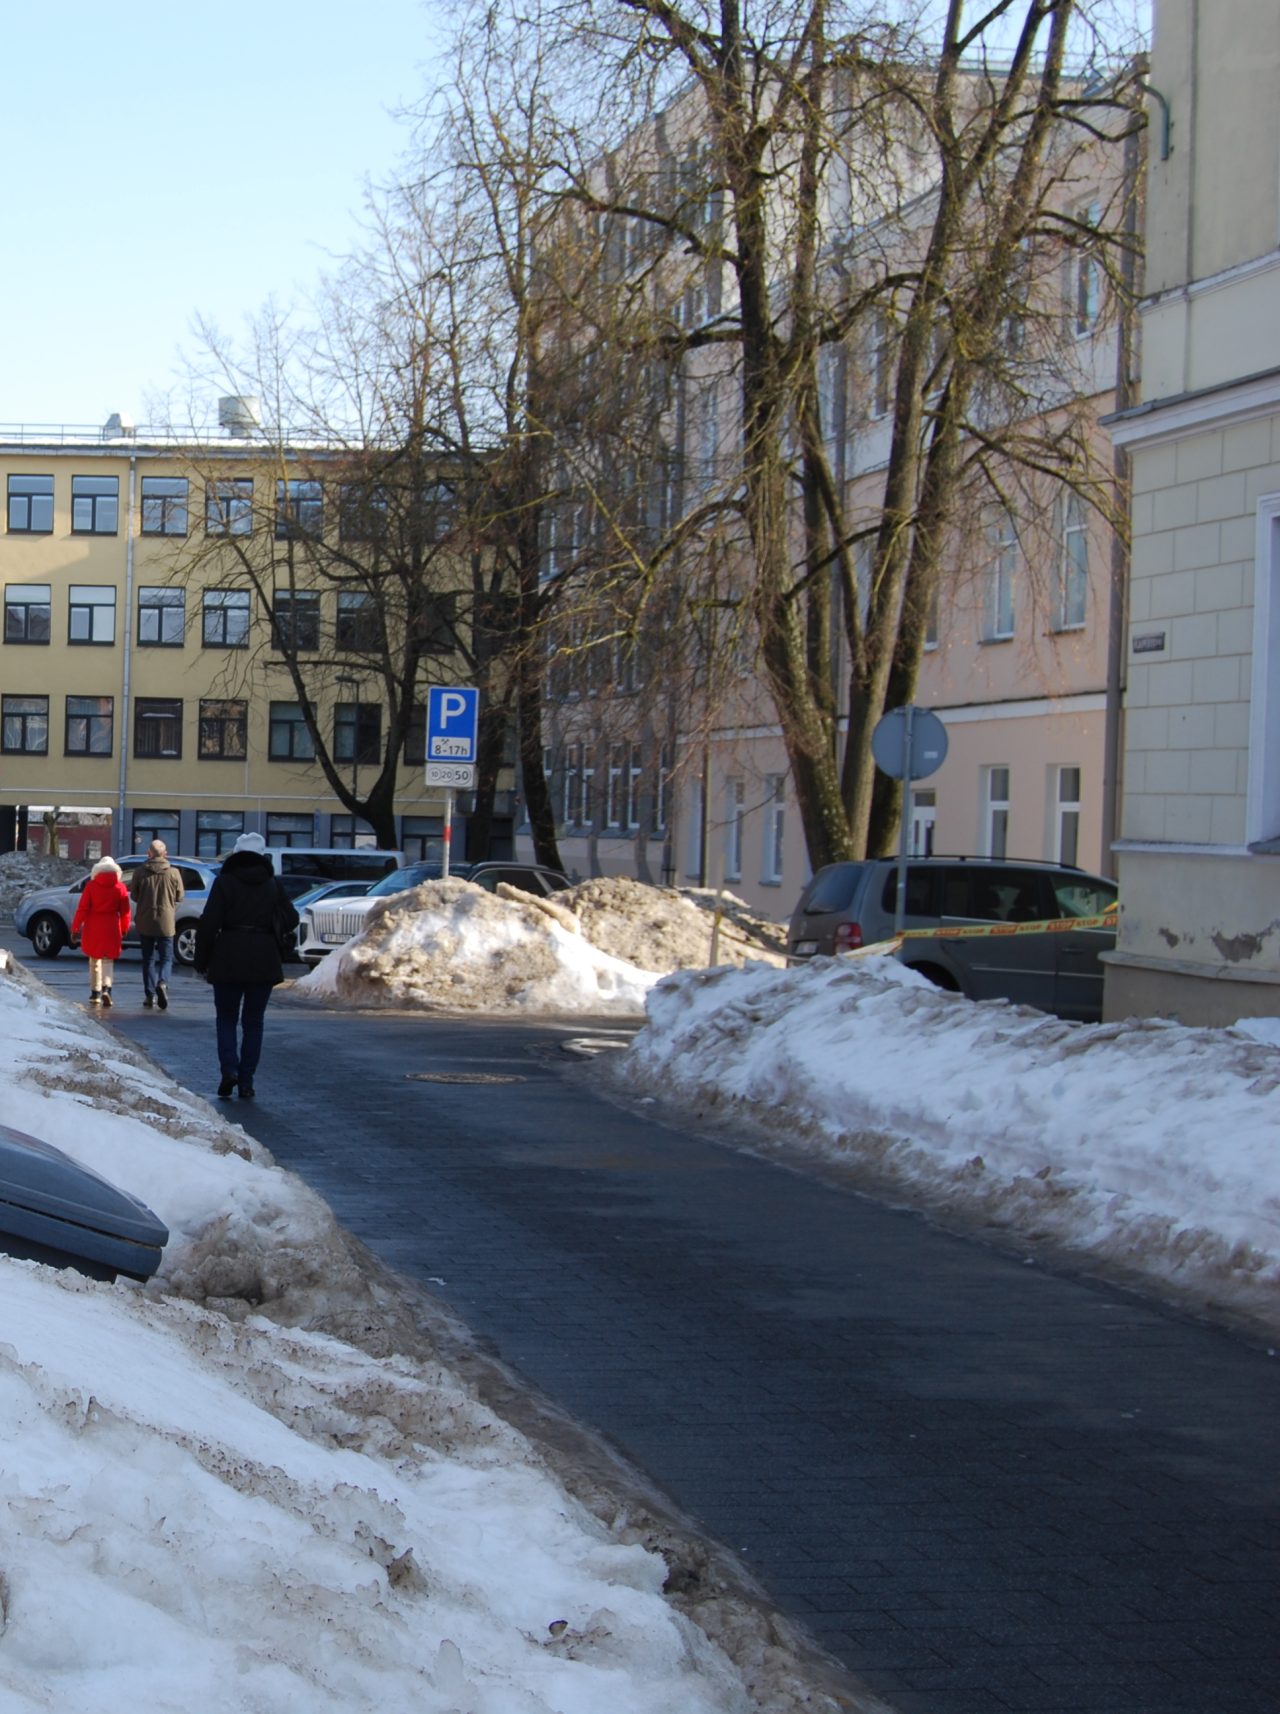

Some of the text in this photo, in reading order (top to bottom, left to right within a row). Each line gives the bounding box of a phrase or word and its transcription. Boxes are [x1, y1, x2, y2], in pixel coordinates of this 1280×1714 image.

[440, 692, 466, 729] P
[441, 771, 452, 779] 20
[455, 770, 469, 780] 50
[1076, 918, 1098, 926] STOP
